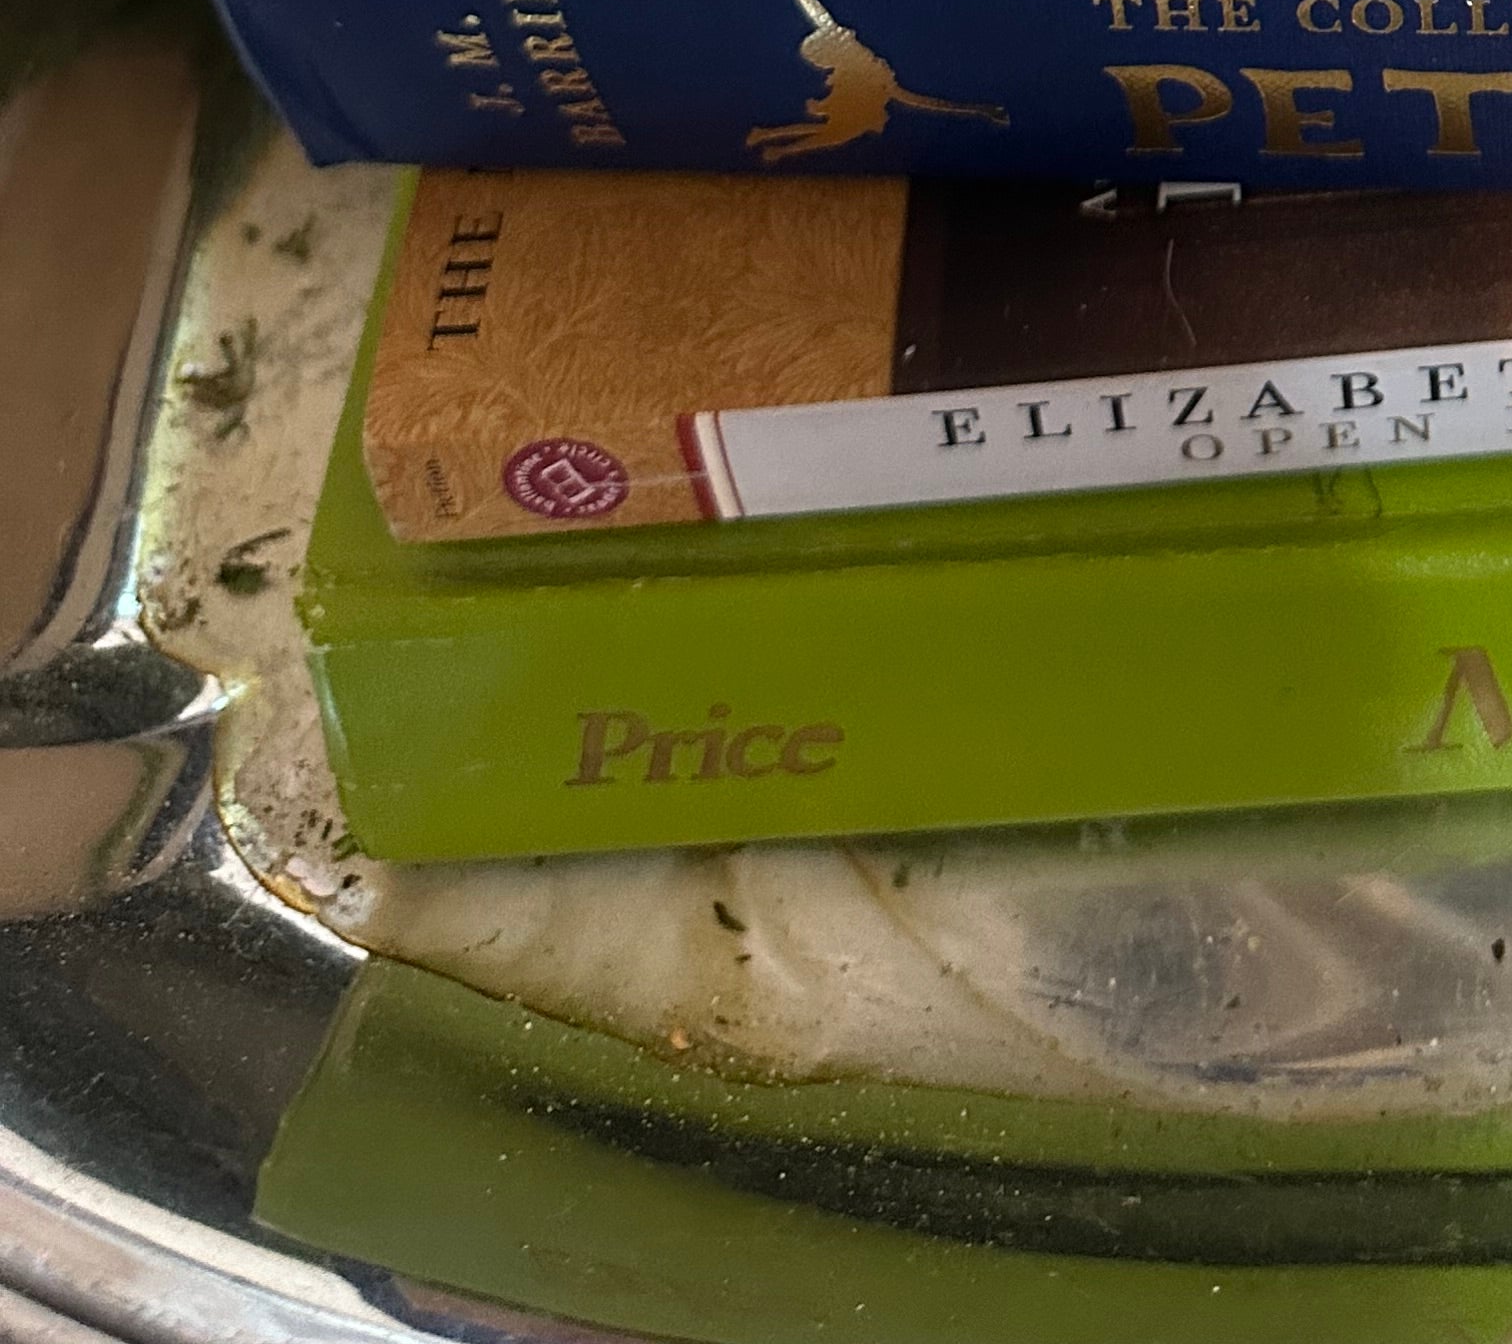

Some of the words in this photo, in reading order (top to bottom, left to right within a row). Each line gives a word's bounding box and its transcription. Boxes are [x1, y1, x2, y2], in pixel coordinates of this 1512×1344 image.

[435, 14, 499, 67] M.
[468, 83, 526, 116] J.
[427, 212, 503, 351] THE
[1180, 412, 1437, 463] OPEN
[562, 701, 846, 788] Price
